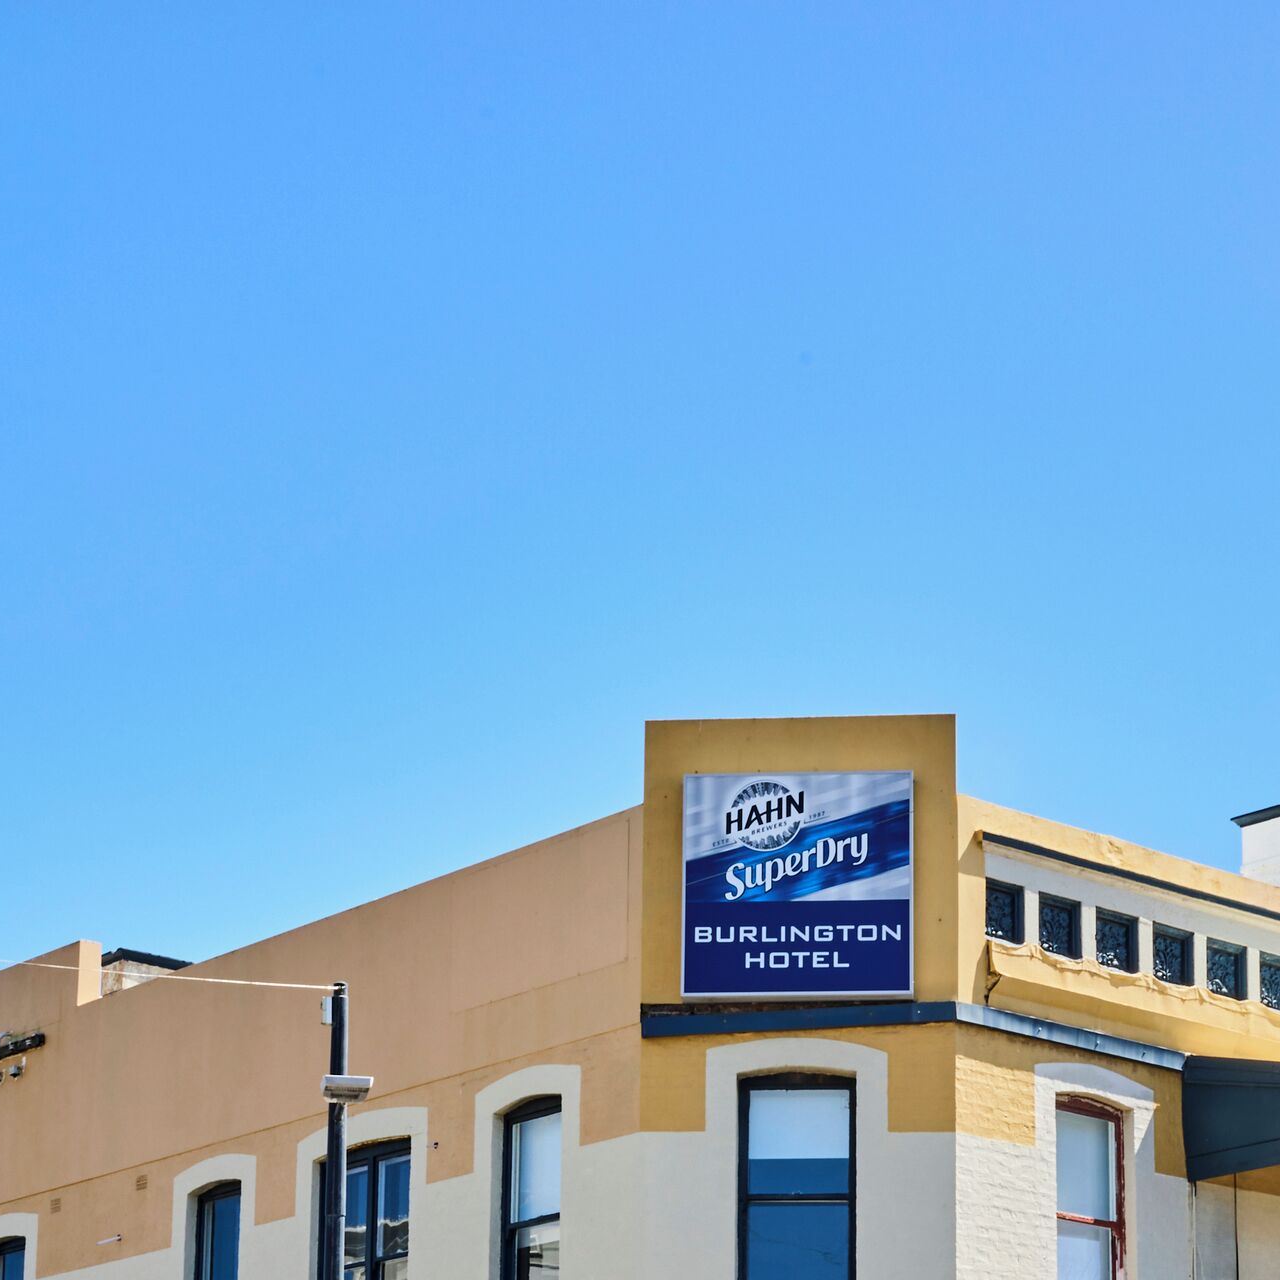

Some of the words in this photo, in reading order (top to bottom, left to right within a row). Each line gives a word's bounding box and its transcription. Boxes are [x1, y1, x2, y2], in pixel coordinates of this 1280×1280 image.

[725, 790, 805, 835] HAHN
[751, 821, 787, 835] BREWERS
[724, 832, 869, 901] SuperDry
[694, 925, 901, 943] BURLINGTON
[745, 951, 850, 969] HOTEL
